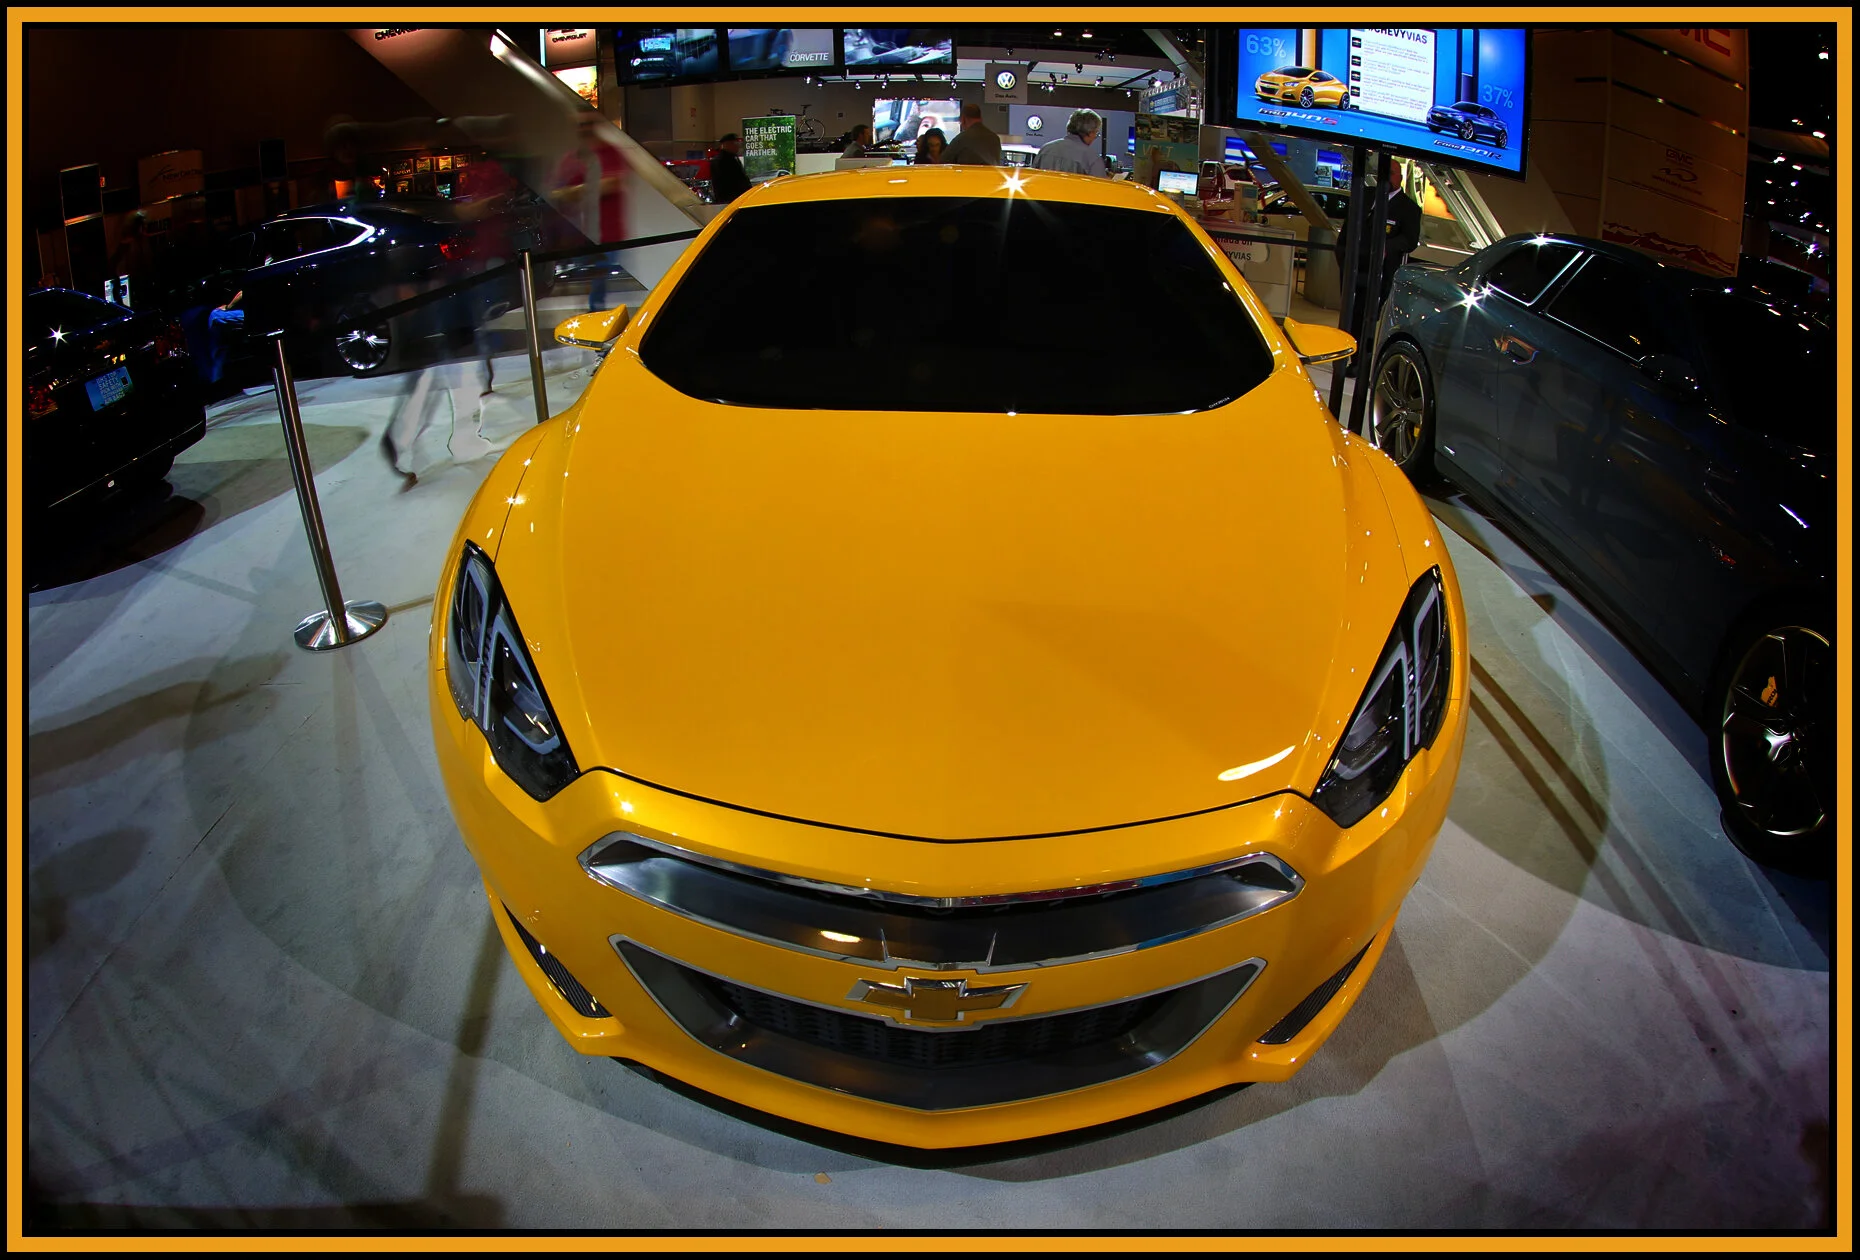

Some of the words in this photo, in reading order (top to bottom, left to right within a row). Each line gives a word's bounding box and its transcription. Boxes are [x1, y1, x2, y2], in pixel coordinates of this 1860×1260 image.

[1246, 33, 1287, 58] 63%
[790, 52, 829, 62] CORVETTE
[1482, 83, 1514, 109] 37%
[744, 127, 759, 135] THE
[759, 125, 793, 134] ELECTRIC
[759, 133, 777, 141] THAT
[745, 141, 764, 149] GOES
[745, 149, 777, 157] FARTHER.
